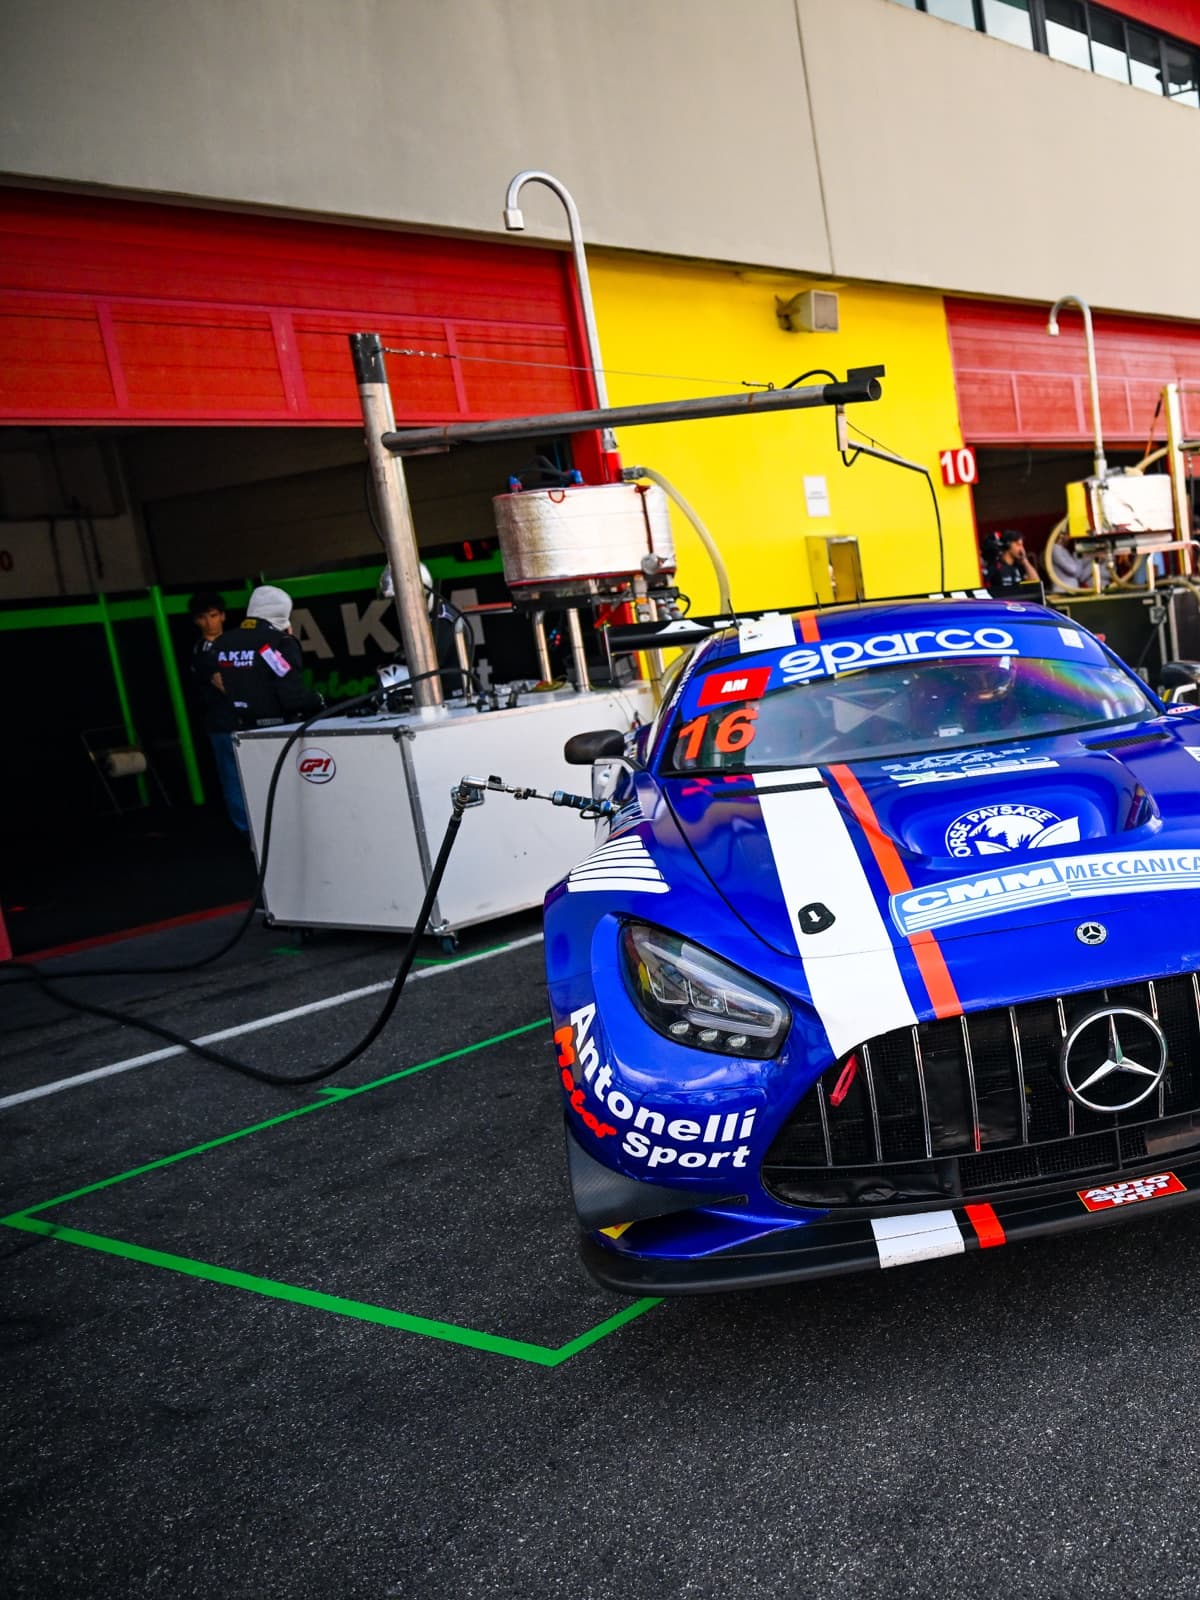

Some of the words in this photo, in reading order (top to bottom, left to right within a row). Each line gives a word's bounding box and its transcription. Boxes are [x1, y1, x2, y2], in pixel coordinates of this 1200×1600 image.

[940, 449, 976, 485] 10
[218, 650, 255, 662] AKM
[778, 627, 1015, 675] sparco
[721, 678, 749, 695] AM
[679, 707, 760, 760] 16
[299, 758, 331, 773] GP1
[967, 805, 1053, 824] PAYSAGE
[901, 863, 1053, 914] CMM
[569, 1002, 758, 1143] Antonelli
[622, 1131, 751, 1168] Sport
